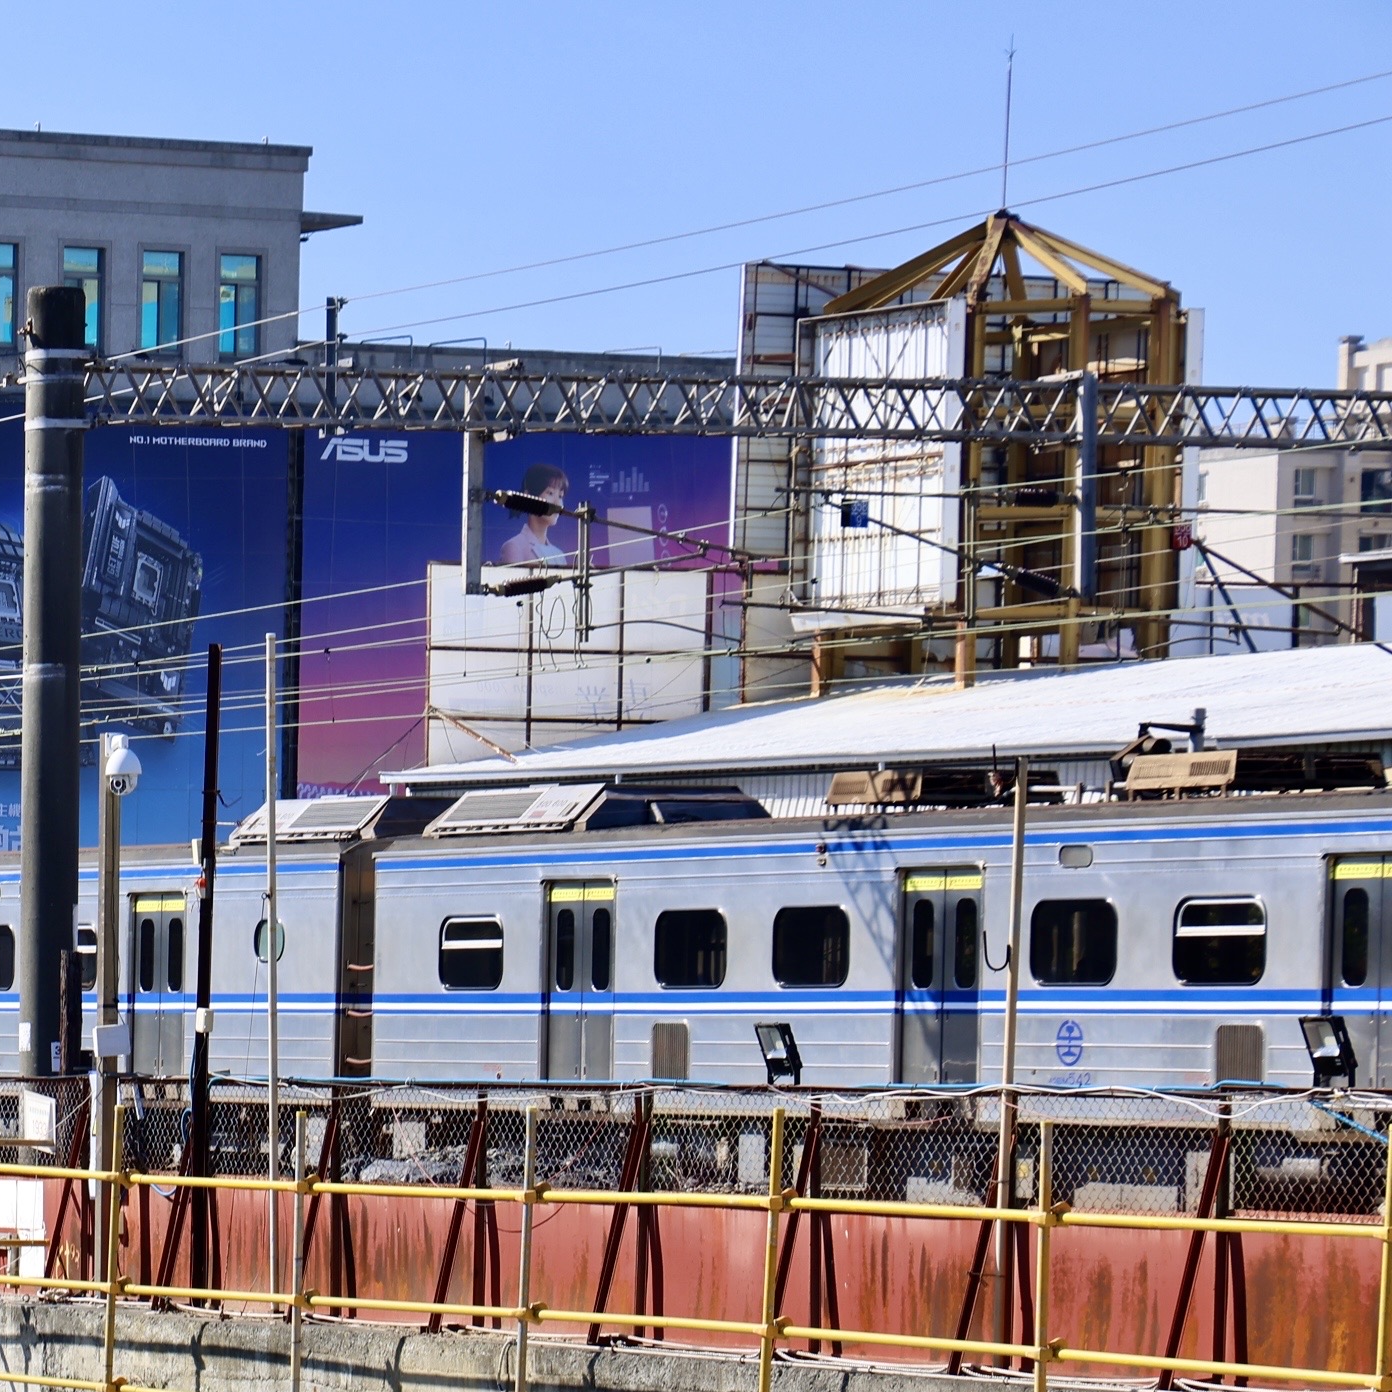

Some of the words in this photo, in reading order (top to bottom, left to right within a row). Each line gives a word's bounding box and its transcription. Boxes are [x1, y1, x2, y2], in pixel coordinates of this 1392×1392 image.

[129, 436, 150, 445] NO.1
[153, 436, 230, 447] MOTHERBOARD
[232, 438, 267, 448] BRAND
[320, 438, 408, 463] ASUS
